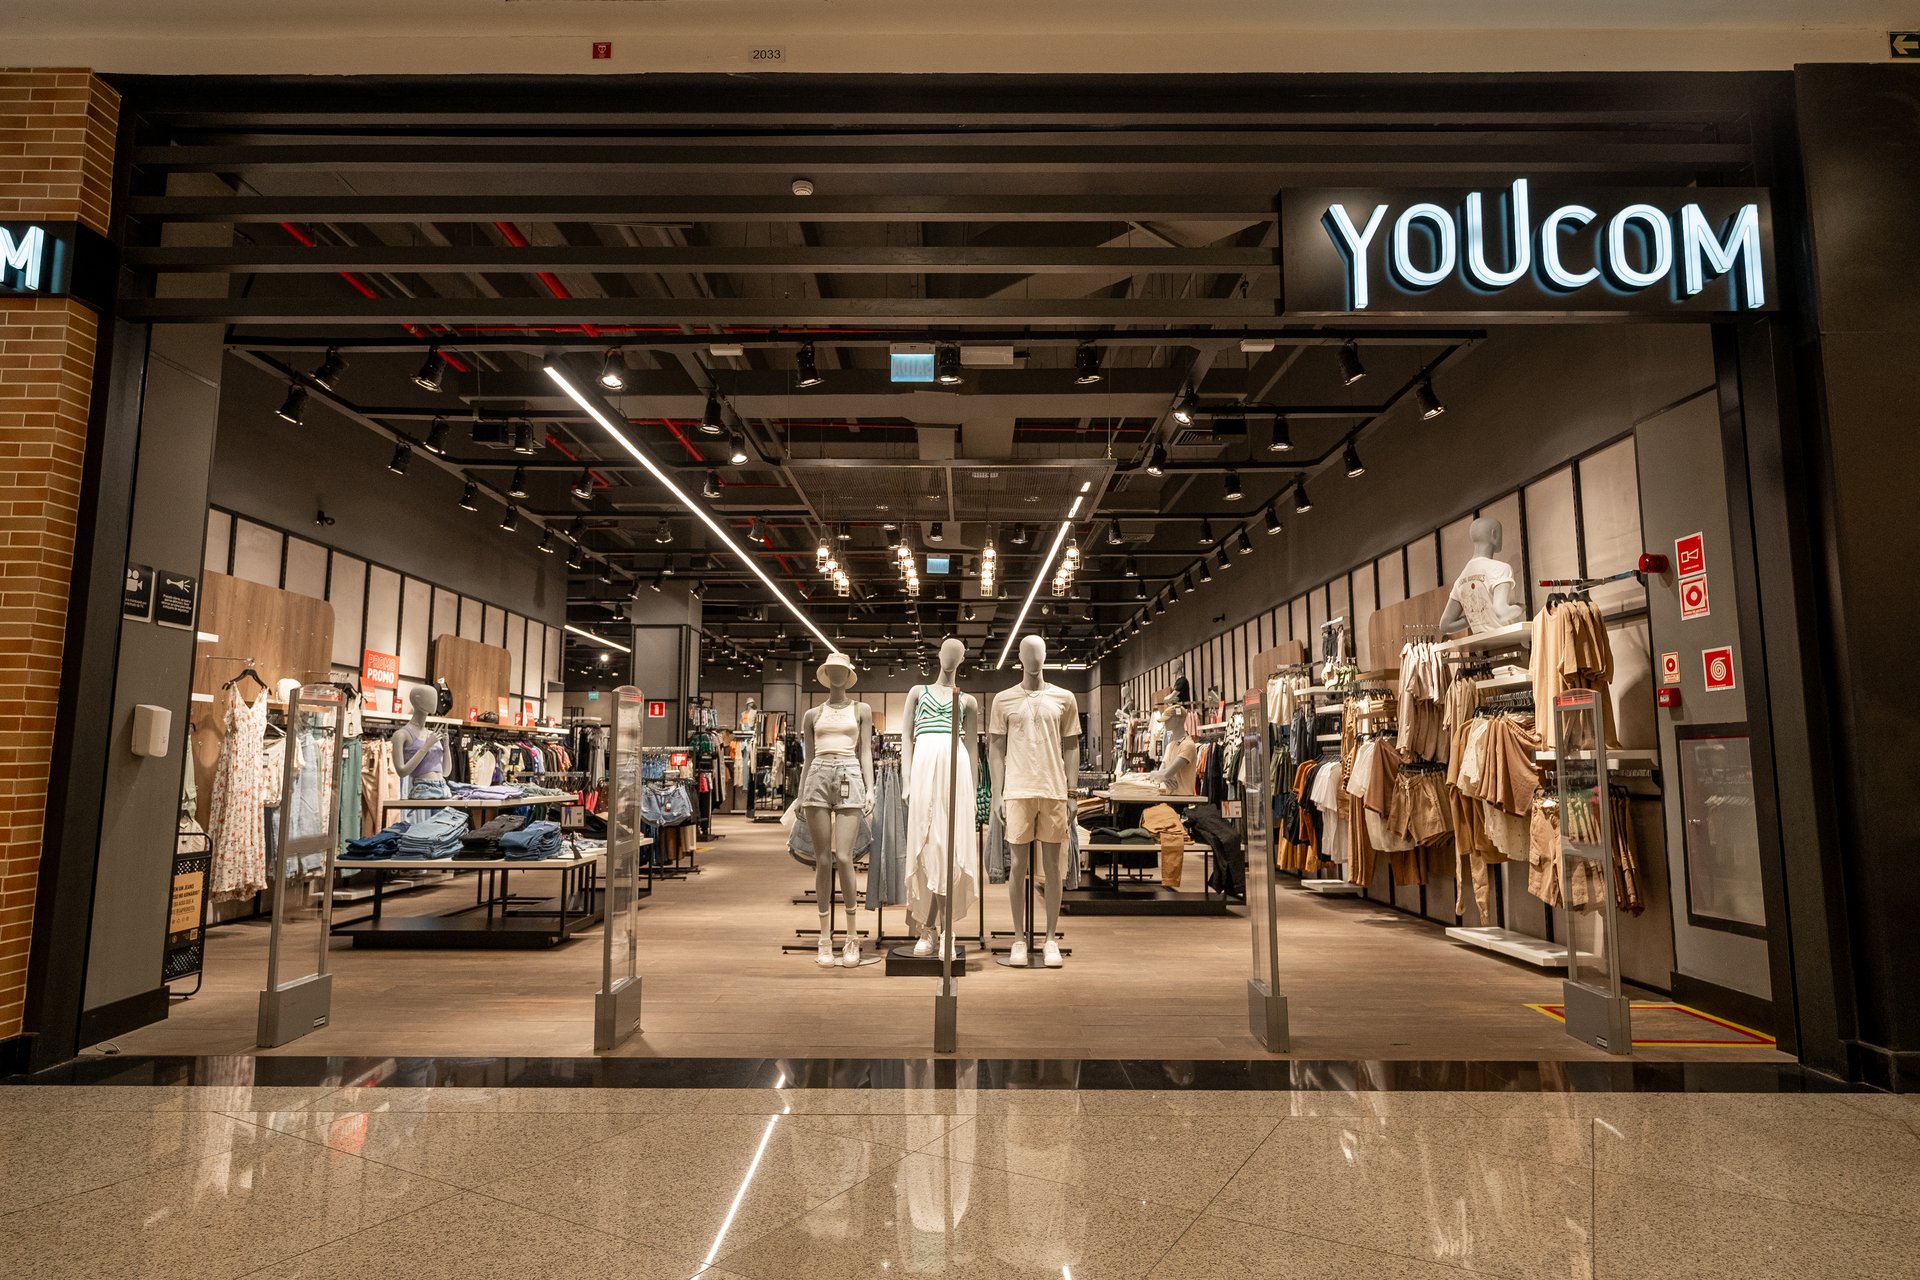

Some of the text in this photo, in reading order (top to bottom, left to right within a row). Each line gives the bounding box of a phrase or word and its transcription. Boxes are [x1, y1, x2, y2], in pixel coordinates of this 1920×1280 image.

[753, 49, 781, 60] 2033
[1326, 178, 1765, 309] YOUCOM
[367, 667, 394, 684] PROMO
